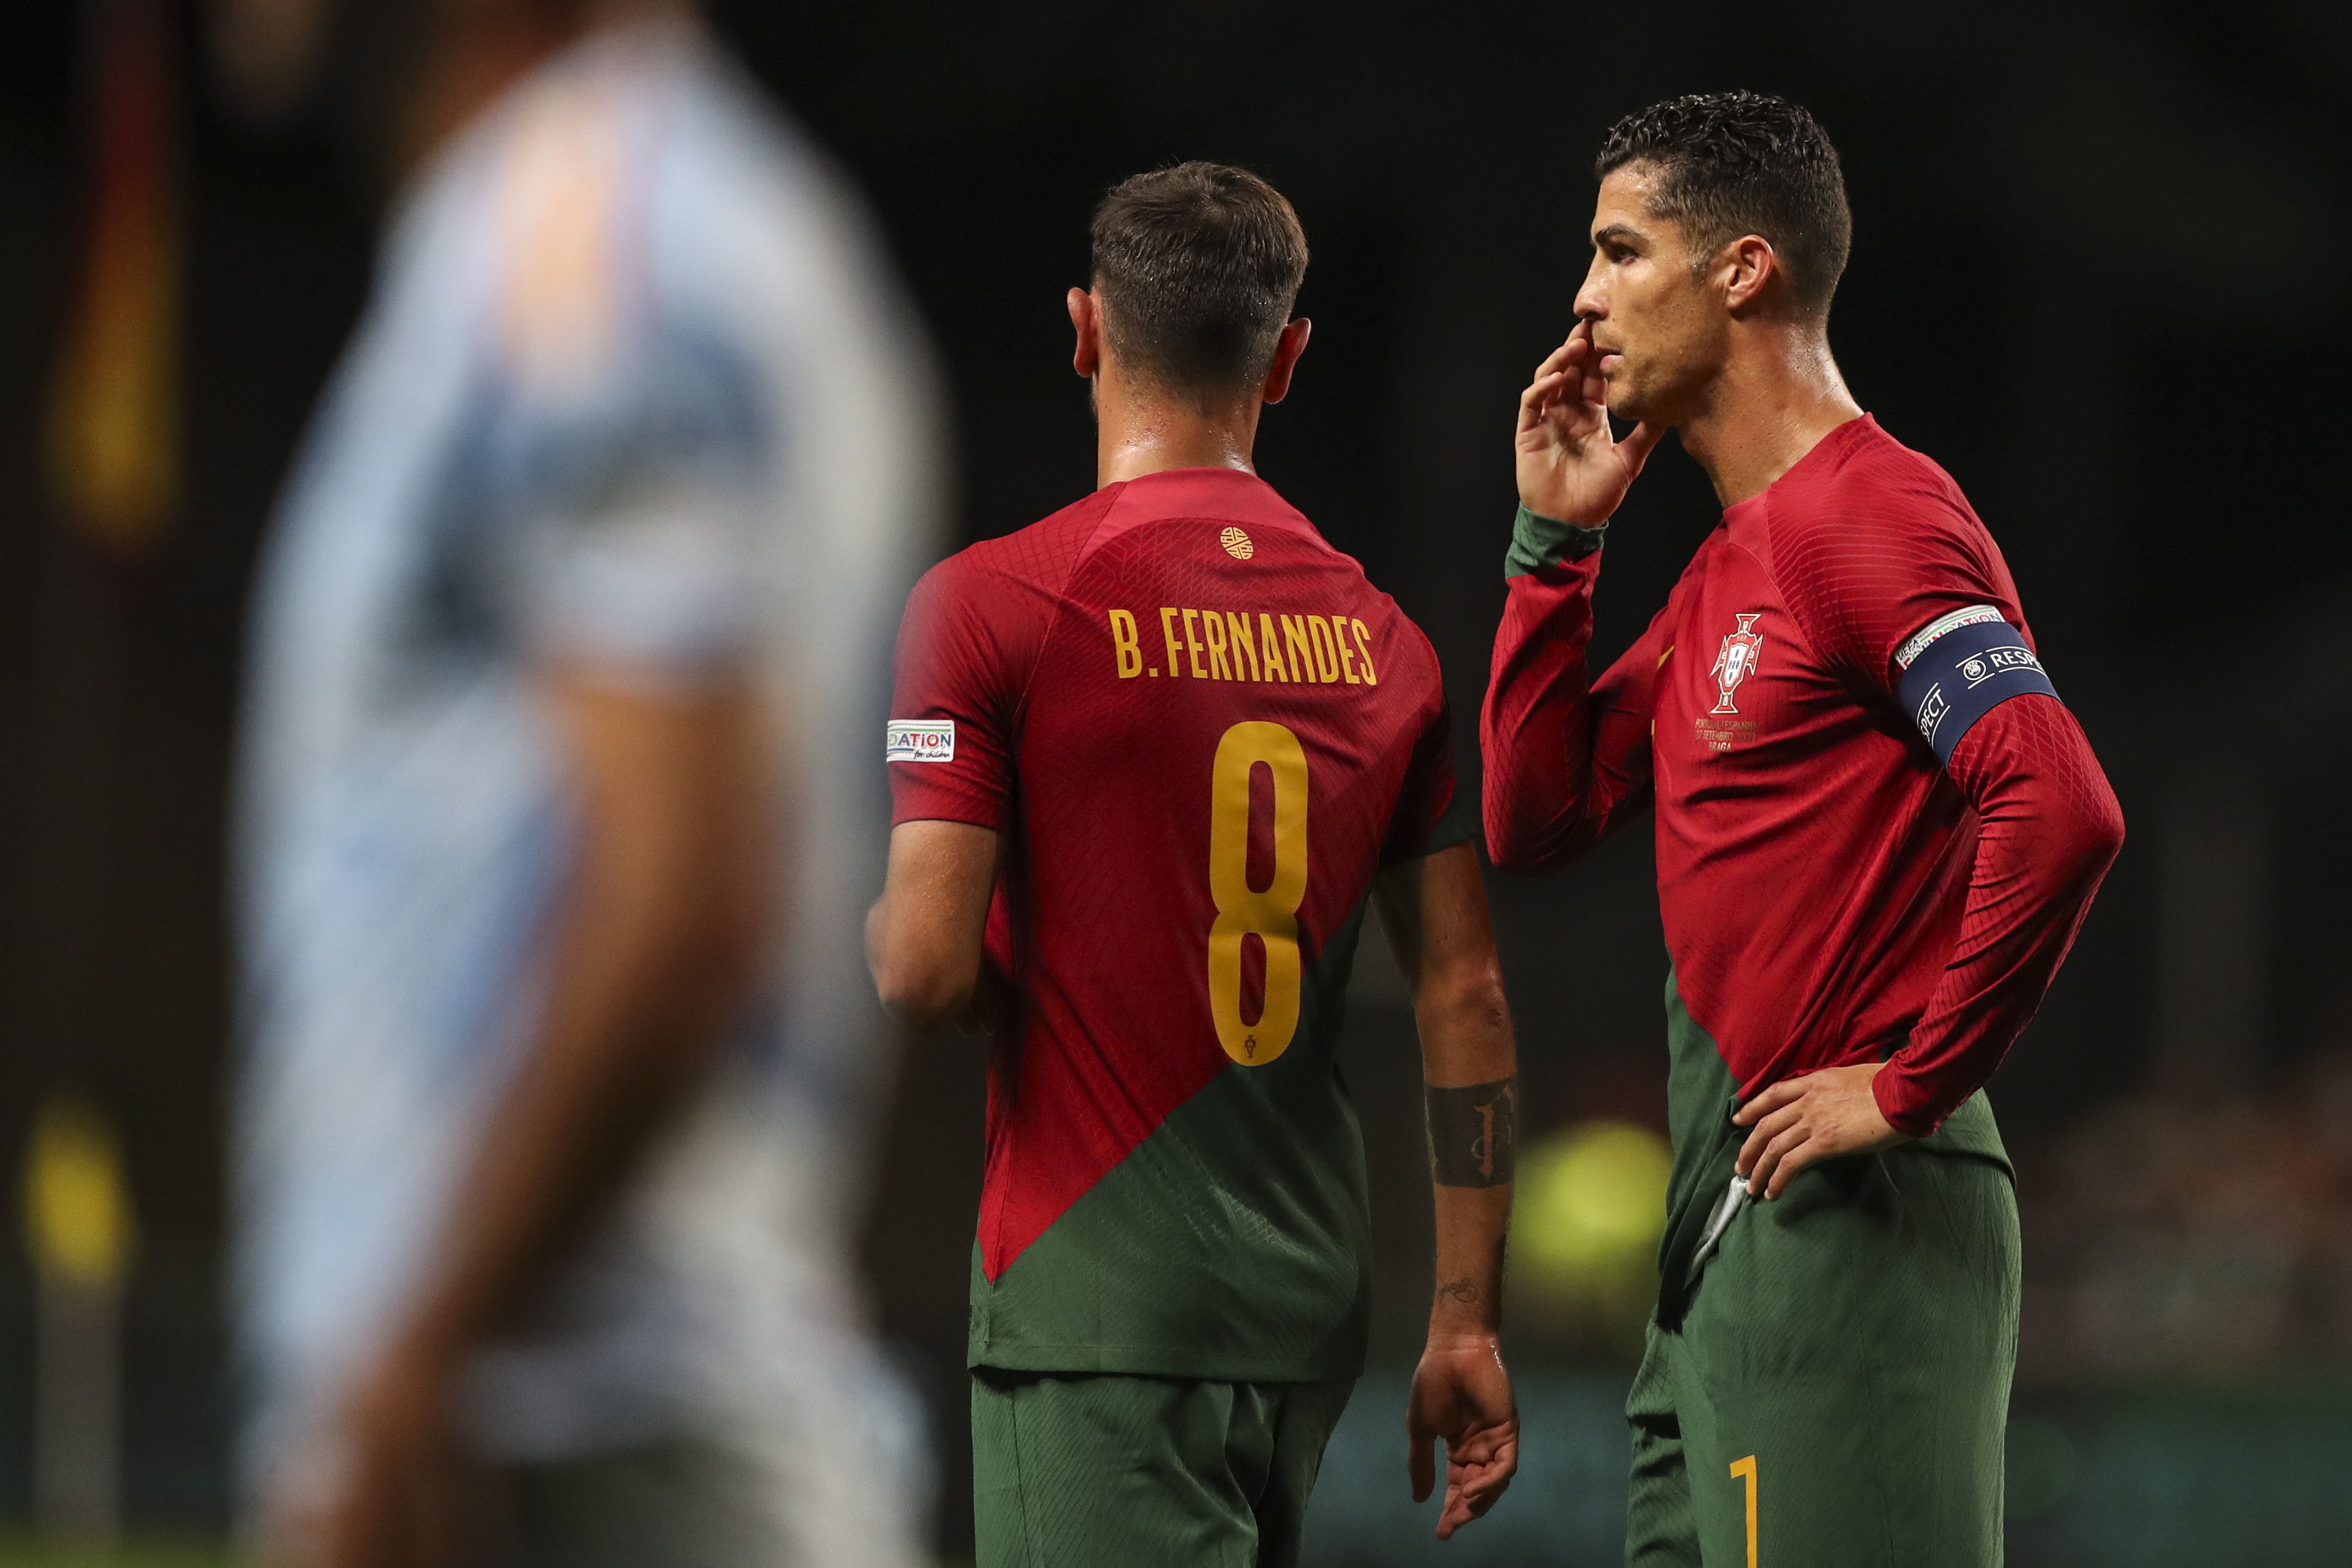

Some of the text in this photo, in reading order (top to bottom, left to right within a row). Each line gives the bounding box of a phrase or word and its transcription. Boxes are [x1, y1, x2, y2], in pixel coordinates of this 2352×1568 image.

[1709, 741, 1732, 751] BRAGA
[914, 749, 923, 760] for
[1208, 720, 1309, 1067] 8
